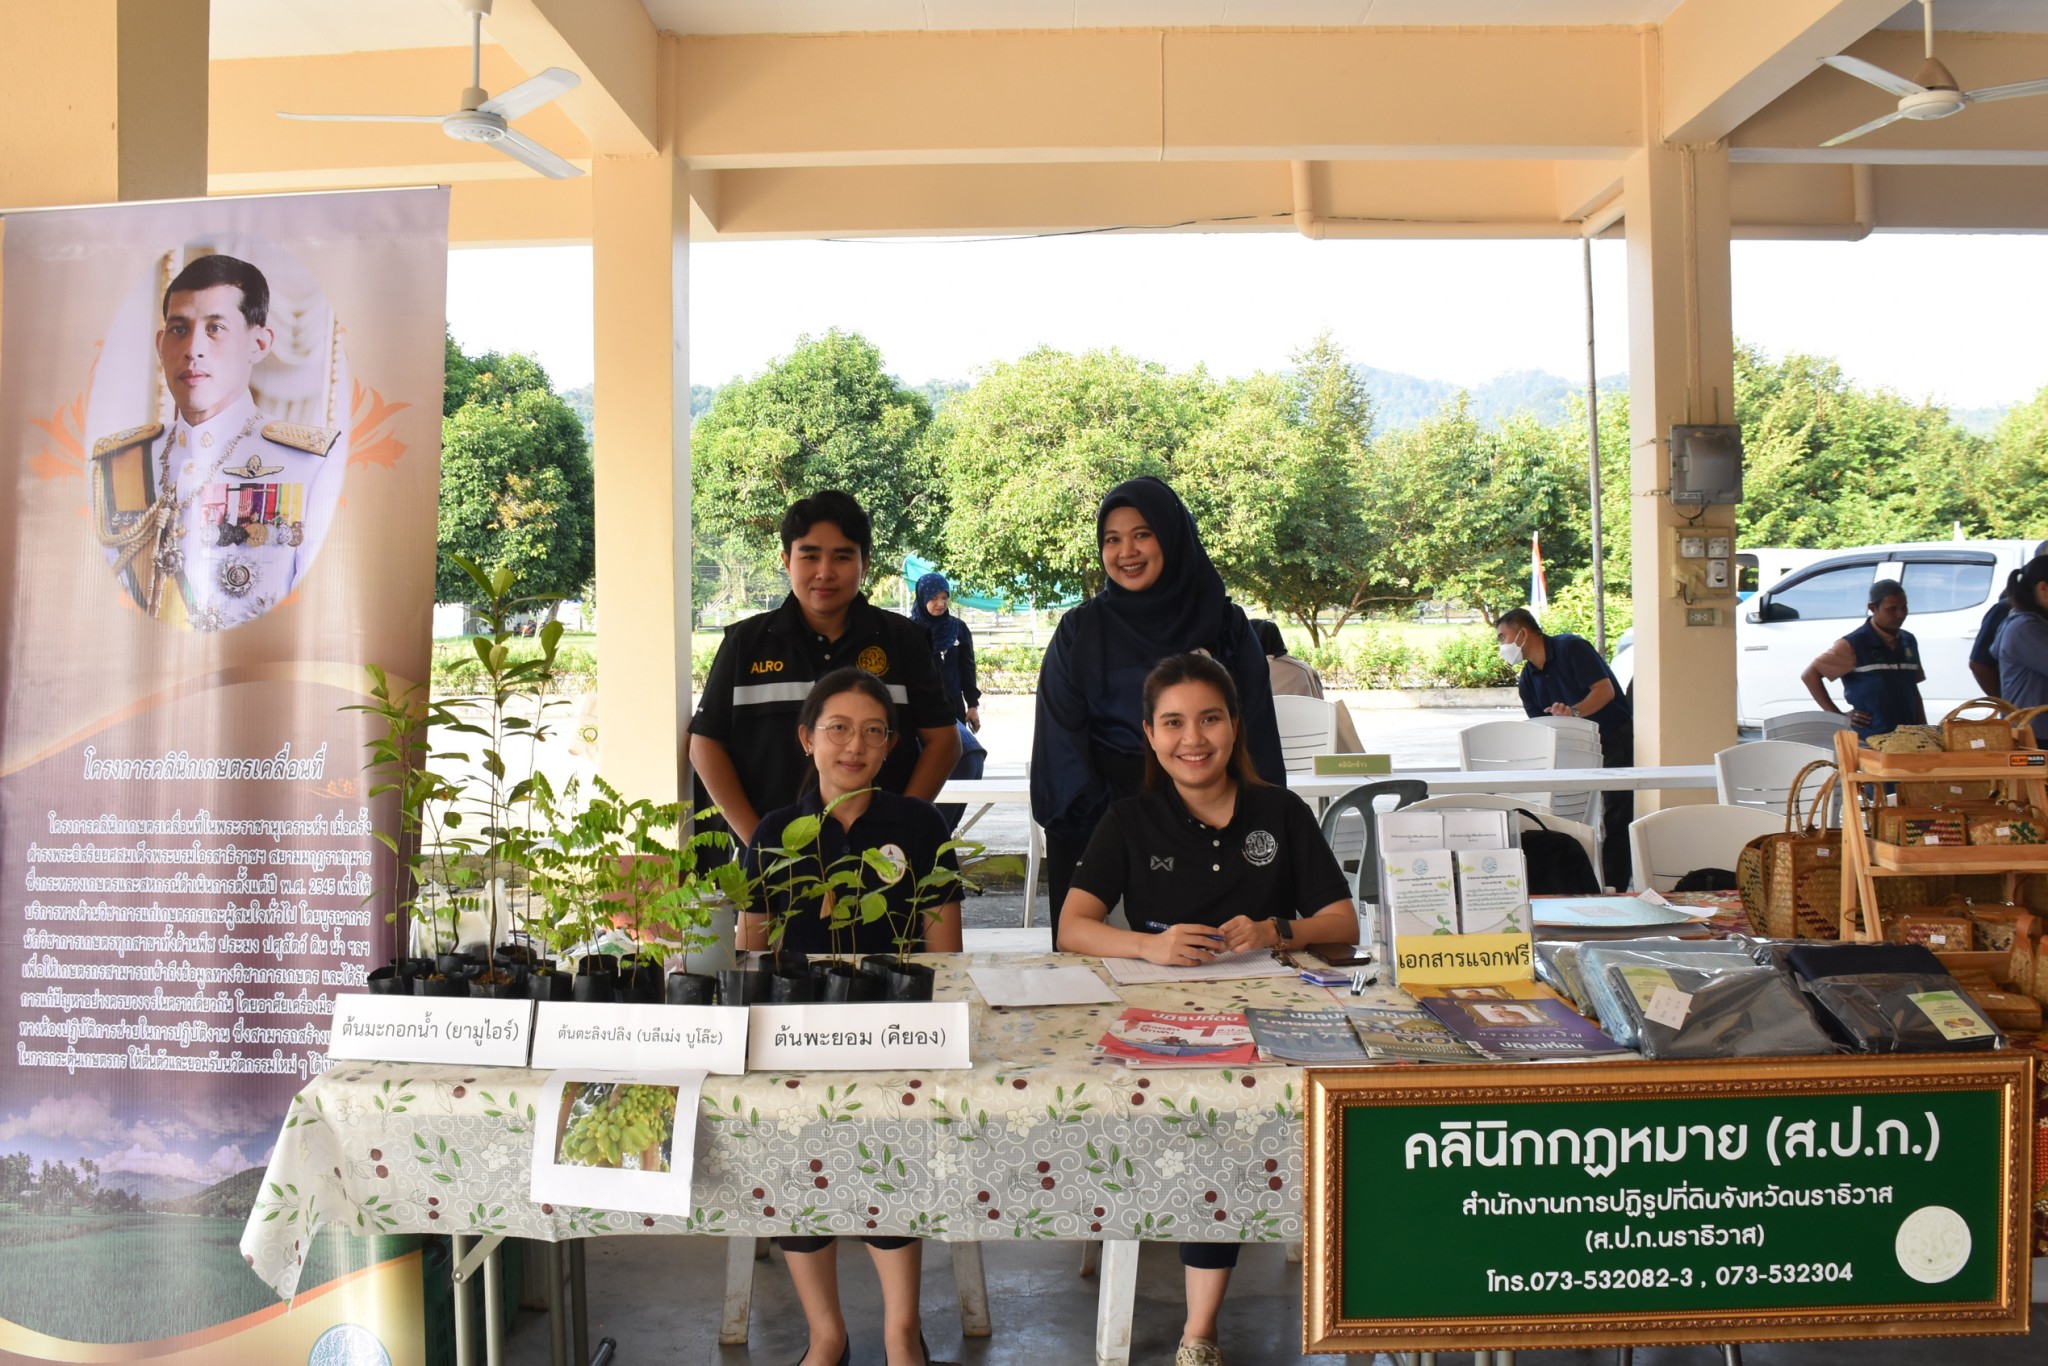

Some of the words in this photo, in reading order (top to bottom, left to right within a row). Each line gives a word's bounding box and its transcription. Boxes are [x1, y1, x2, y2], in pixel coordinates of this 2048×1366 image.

[751, 660, 783, 674] ALRO
[84, 741, 327, 779] โครงการคลินิกเกษตรเคลื่อนที่
[48, 809, 327, 842] โครงการคลินิกเกษตรเคลื่อนที่ในพระราชานุเคราะห์ฯ
[330, 807, 372, 836] เมื่อครั้ง
[27, 840, 266, 865] ดำรงพระอิสริยยศสมเด็จพระบรมโอรสาธิราชฯ
[26, 866, 277, 893] ซึ่งกระทรวงเกษตรและสหกรณ์ดำเนินการตั้งแต่ปี
[280, 878, 306, 894] พ.ศ.
[309, 879, 335, 895] 2545
[337, 871, 372, 895] เพื่อให้
[24, 898, 296, 930] บริการทางด้านวิชาการแก่เกษตรกรและผู้สนใจทั่วไป
[300, 900, 371, 931] โดยบูรณาการ
[23, 924, 215, 957] นักวิชาการเกษตรทุกสาขาทั้งด้านพืช
[219, 936, 259, 954] ประมง
[263, 932, 307, 960] ปศุสัตว์
[310, 934, 327, 955] ดิน
[330, 927, 346, 956] น้ำ
[347, 941, 371, 957] ฯลฯ
[1398, 943, 1530, 969] เอกสารแจกฟรี
[22, 953, 318, 988] เพื่อให้เกษตรกรสามารถเข้าถึงข้อมูลทางวิชาการเกษตร
[21, 986, 234, 1014] การแก้ปัญหาอย่างครบวงจรในคราวเดียวกัน
[234, 988, 337, 1014] โดยอาศัยเครื่องมือ
[19, 1015, 230, 1047] ทางห้องปฏิบัติการช่วยในการปฏิบัติงาน
[342, 1011, 438, 1038] ต้นมะกอกน้ำ
[446, 1018, 519, 1046] (ยามูไอร์)
[558, 1024, 632, 1041] ต้นตะลิงปลิง
[775, 1024, 872, 1046] ต้นพะยอม
[881, 1024, 946, 1048] (คียอง)
[17, 1041, 128, 1074] ในการกระตุ้นเกษตรกร
[128, 1043, 297, 1074] ให้ตื่นตัวและยอมรับนวัตกรรมใหม่
[1766, 1105, 1941, 1167] (ส.ป.ก.)
[1462, 1181, 1893, 1219] สำนักงานการปฏิรูปที่ดินจังหวัดนราธิวาส
[1585, 1224, 1765, 1253] (ส.ป.ก.นราธิวาส)
[1716, 1262, 1853, 1286] 073-532304
